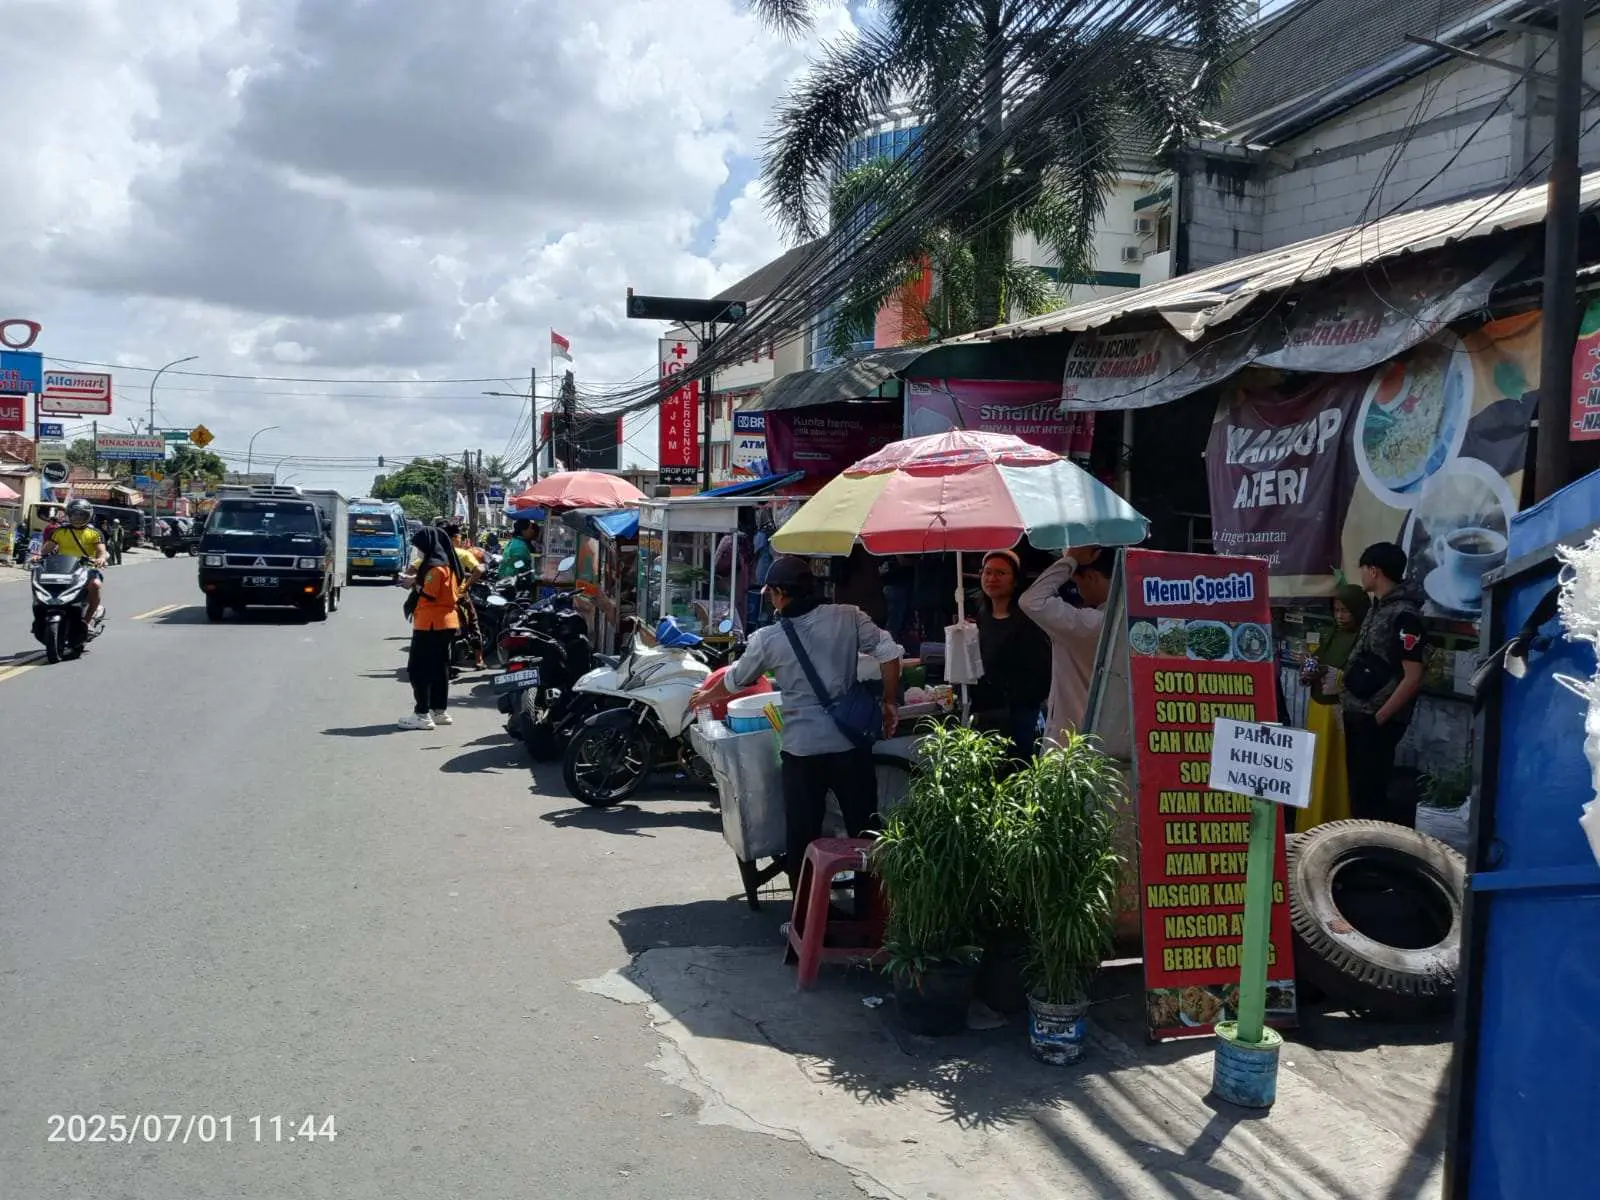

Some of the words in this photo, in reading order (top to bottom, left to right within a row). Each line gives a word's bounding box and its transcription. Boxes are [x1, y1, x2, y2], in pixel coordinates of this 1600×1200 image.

[663, 361, 689, 377] IG
[1066, 360, 1097, 378] RASA
[46, 375, 104, 388] Alfamart
[1016, 424, 1041, 434] KUAT
[740, 440, 764, 449] ATM
[1145, 579, 1192, 604] Menu
[1194, 573, 1253, 604] Spesial
[1154, 671, 1195, 693] SOTO
[1198, 673, 1254, 695] KUNING
[1156, 702, 1196, 723] SOTO
[1200, 702, 1255, 723] BETAWI
[1149, 731, 1181, 752] CAH
[1184, 731, 1214, 752] KAN
[1234, 725, 1294, 748] PARKIR
[1230, 748, 1294, 772] KHUSUS
[1228, 770, 1291, 795] NASGOR
[1159, 791, 1200, 813] AYAM
[1165, 822, 1198, 844] LELE
[1200, 822, 1251, 844] KREME
[1166, 853, 1207, 875] AYAM
[1211, 852, 1248, 875] PENY
[1147, 884, 1210, 907] NASGOR
[1165, 914, 1228, 939] NASGOR
[1163, 946, 1213, 971] BEBEK
